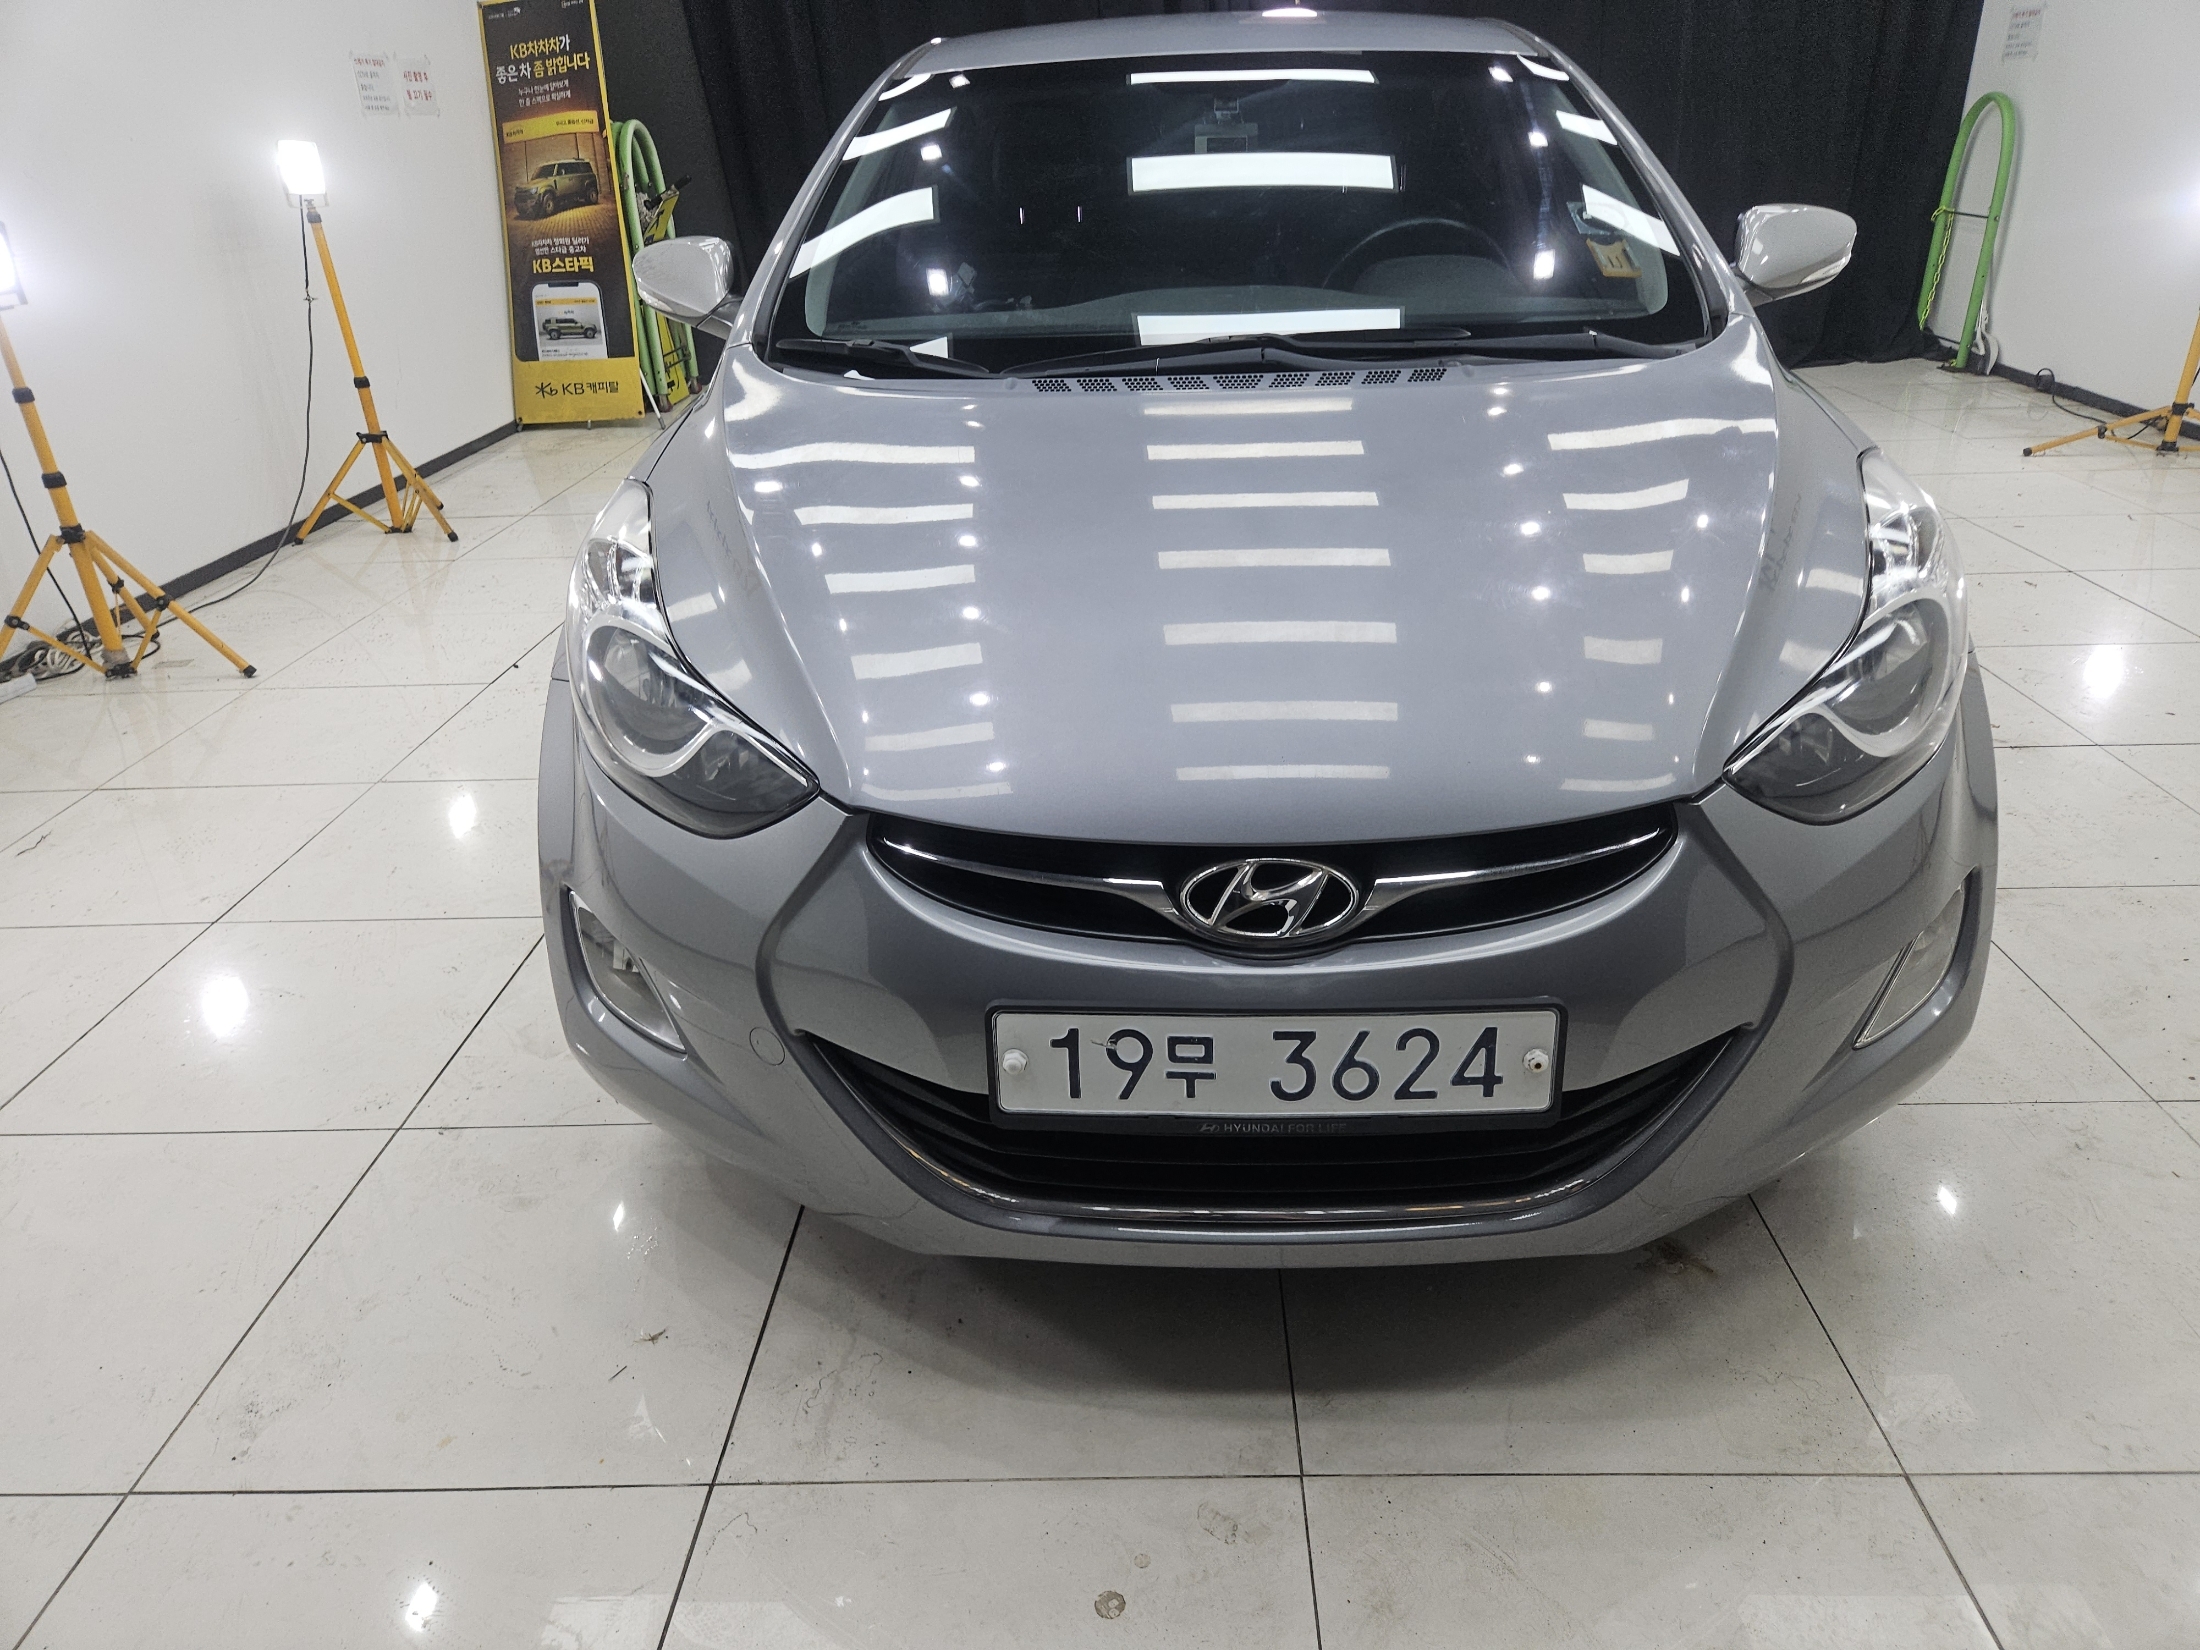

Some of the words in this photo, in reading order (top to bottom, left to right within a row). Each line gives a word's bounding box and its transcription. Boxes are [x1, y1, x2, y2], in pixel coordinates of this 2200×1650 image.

[509, 33, 571, 60] KB차차차가
[495, 64, 518, 85] 좋은
[518, 61, 532, 80] 차
[533, 60, 545, 79] 좀
[532, 256, 595, 274] KB스타픽
[1049, 1027, 1217, 1101] 19무
[1269, 1026, 1504, 1103] 3624
[1224, 1123, 1284, 1133] HYUNDAI
[1287, 1123, 1315, 1133] FOR
[1318, 1123, 1347, 1133] LIFE
